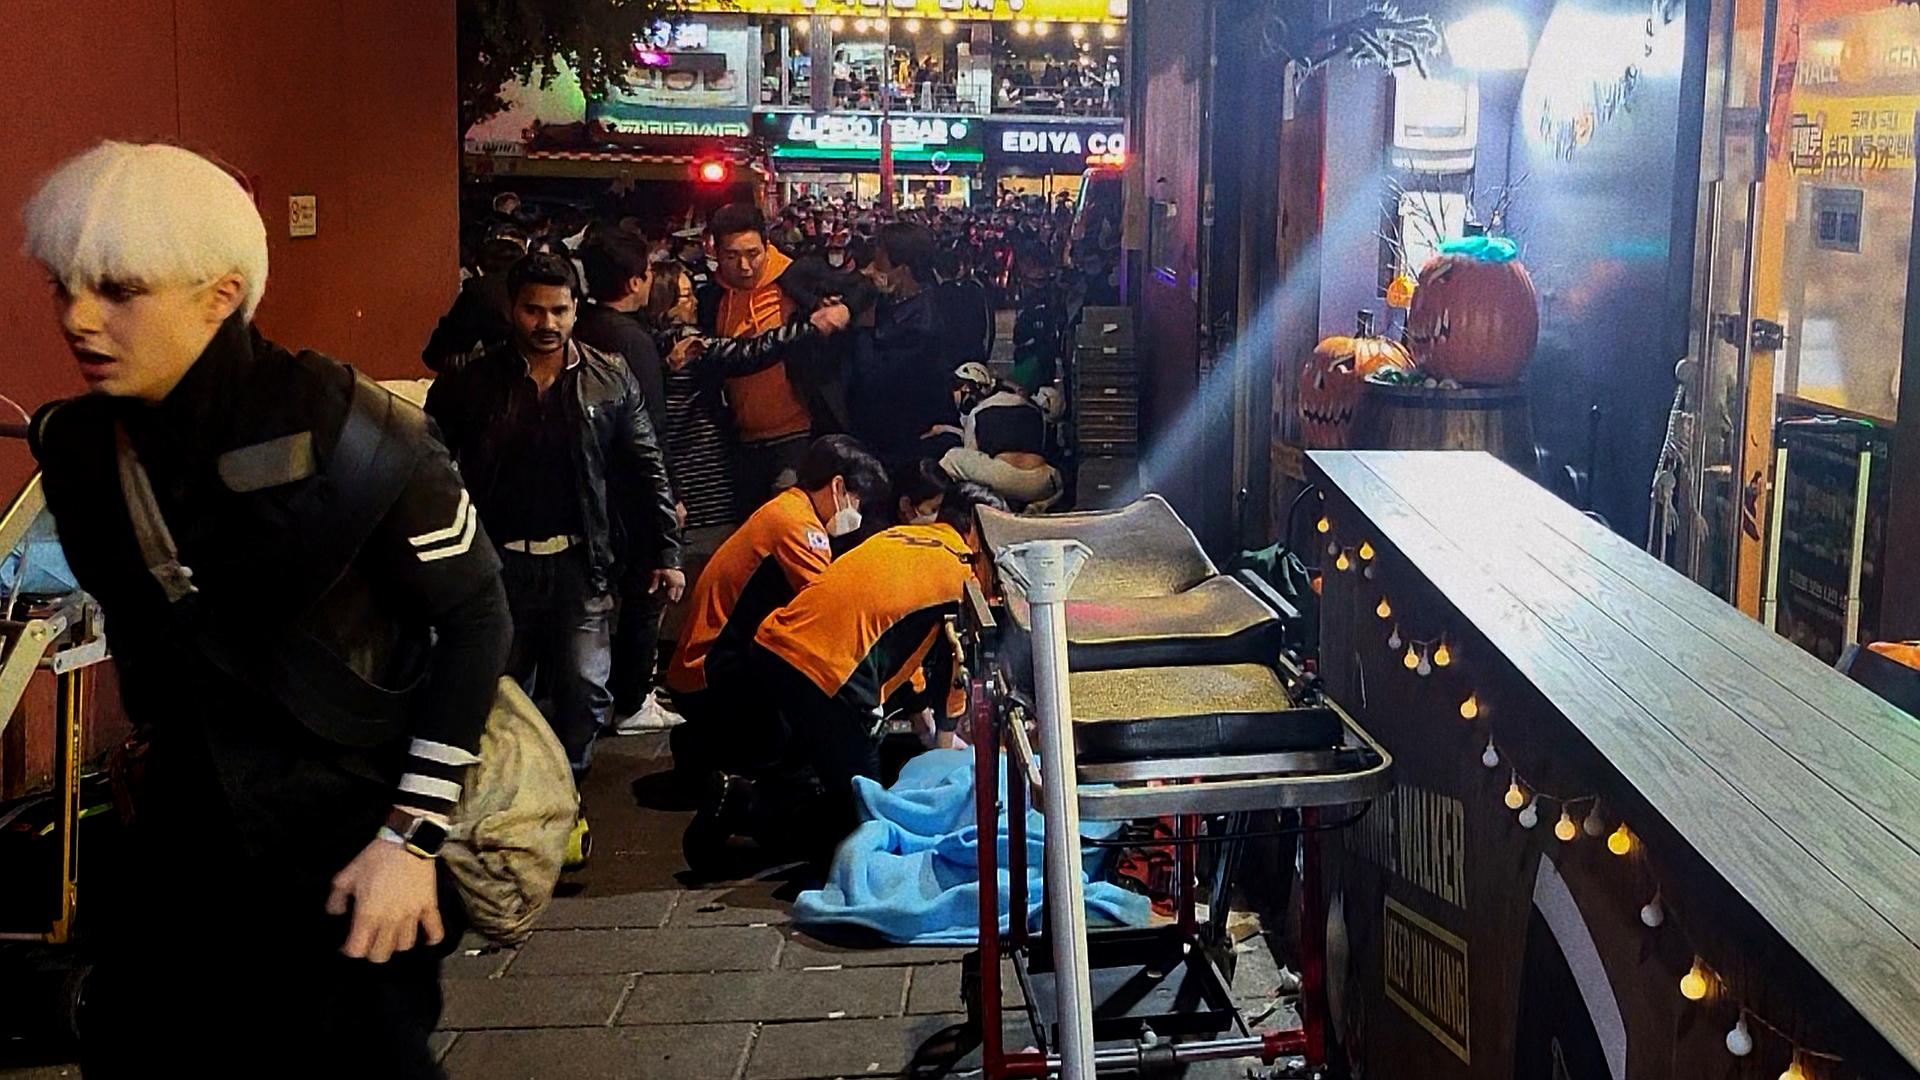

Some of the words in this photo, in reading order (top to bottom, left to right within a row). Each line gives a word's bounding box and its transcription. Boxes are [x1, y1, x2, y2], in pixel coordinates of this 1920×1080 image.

[1002, 131, 1081, 155] EDIYA
[1398, 784, 1468, 910] WALKER
[1387, 914, 1411, 991] KEEP
[1410, 931, 1466, 1037] WALKING
